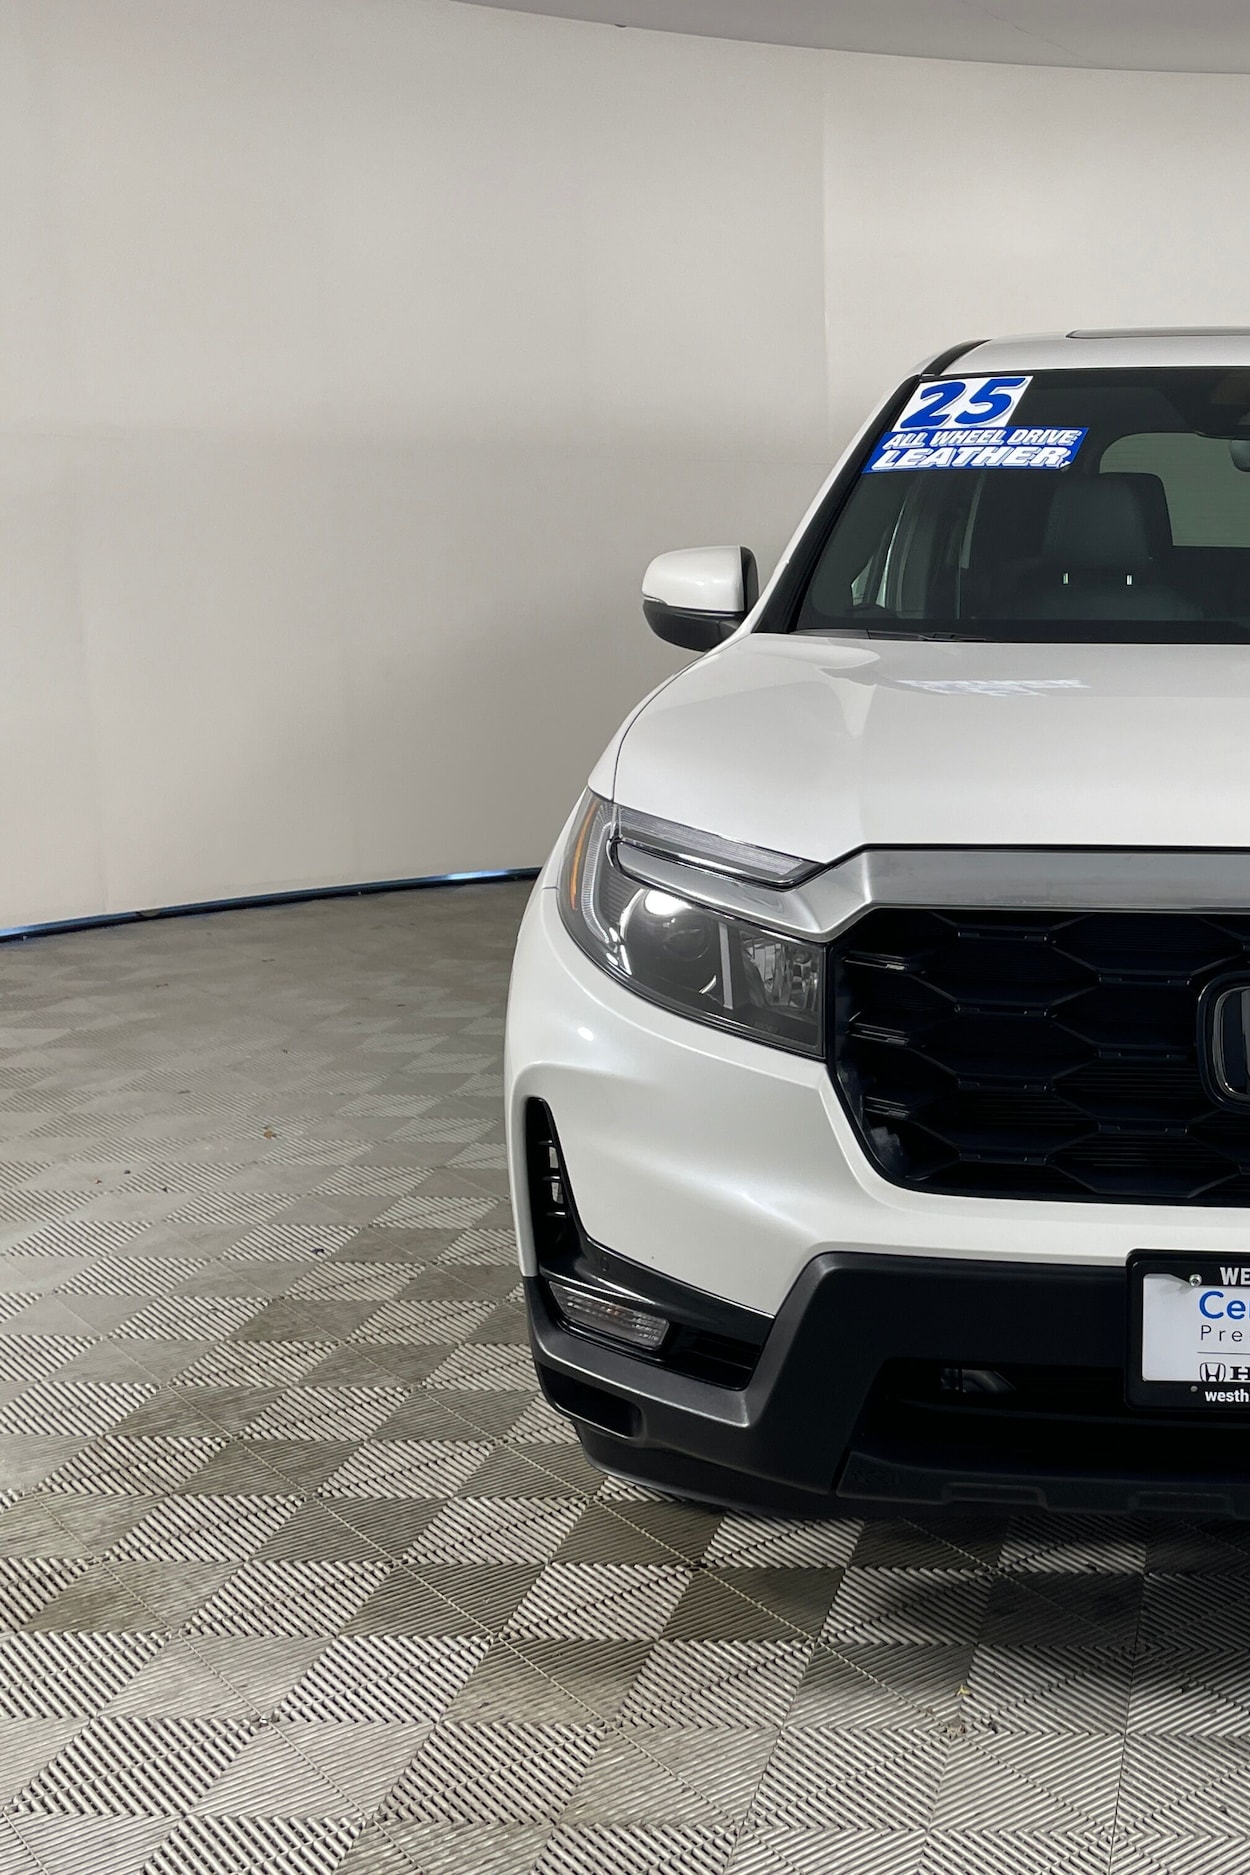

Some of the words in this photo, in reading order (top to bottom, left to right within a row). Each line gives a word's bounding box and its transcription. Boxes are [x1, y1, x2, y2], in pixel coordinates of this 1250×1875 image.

[900, 377, 1026, 429] 25
[883, 432, 928, 448] ALL
[930, 429, 1005, 446] WHEEL
[1007, 430, 1082, 446] DRIVE
[871, 447, 1071, 470] LEATHER
